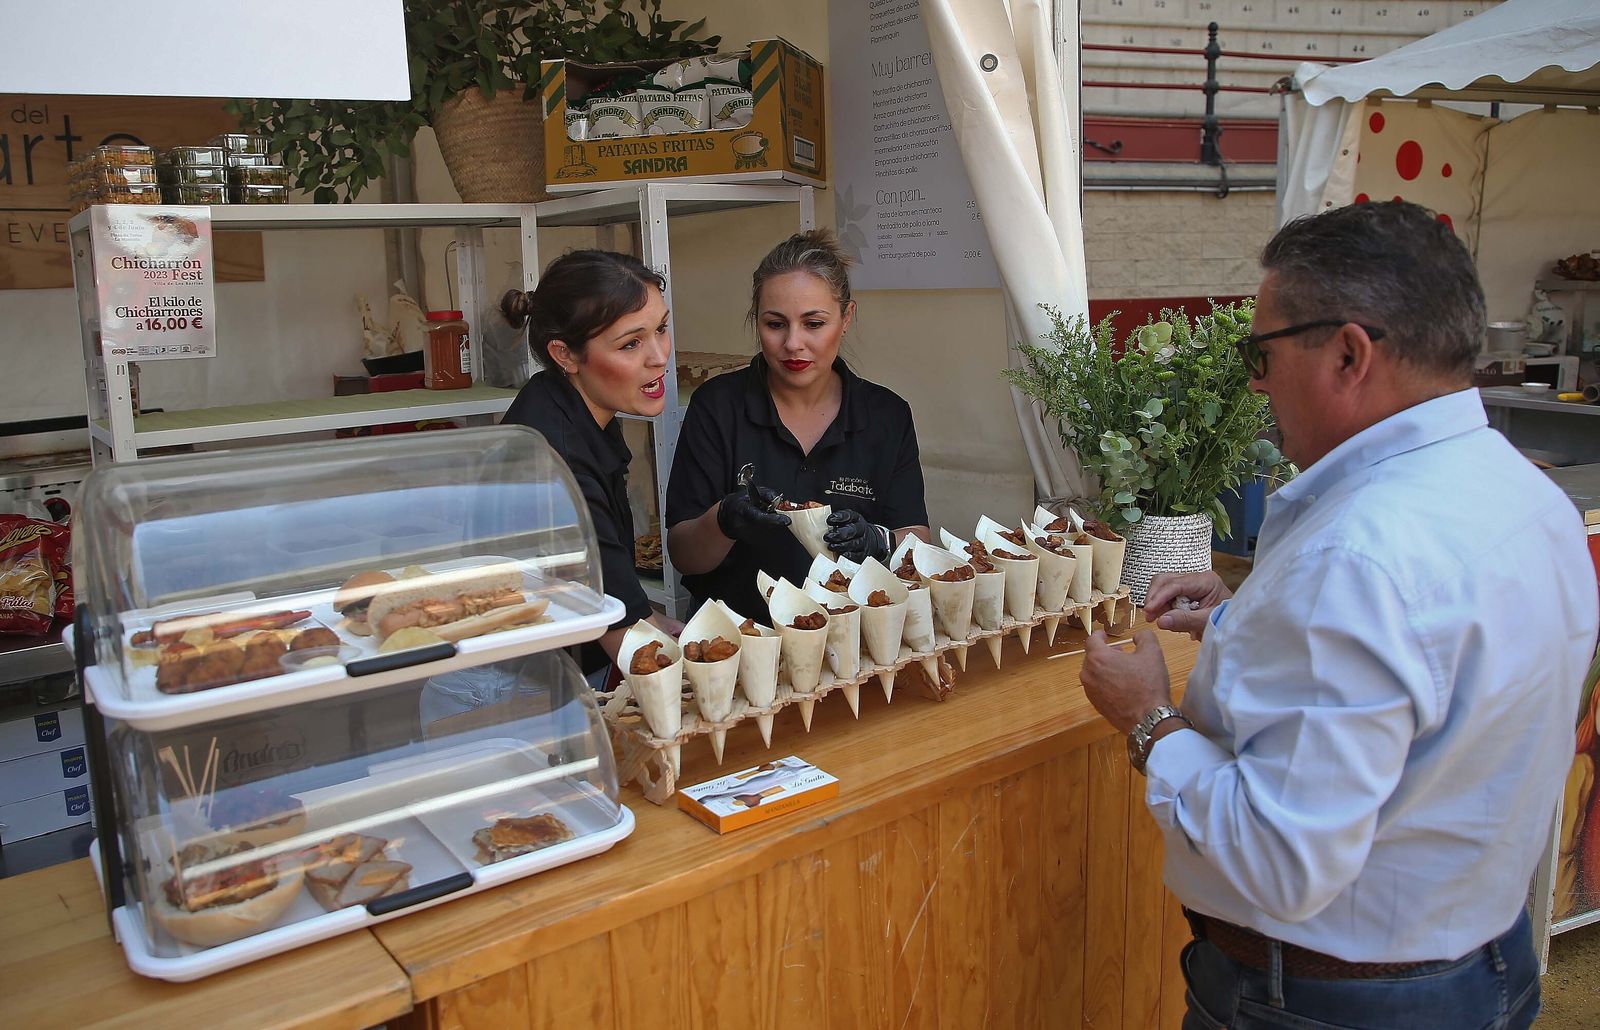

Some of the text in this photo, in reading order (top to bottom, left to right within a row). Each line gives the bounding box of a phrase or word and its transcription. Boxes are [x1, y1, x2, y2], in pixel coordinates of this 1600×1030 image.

[871, 61, 894, 78] Muy
[712, 86, 746, 97] PATATAS
[639, 93, 704, 103] PATATAS FRITAS
[11, 104, 49, 124] del
[594, 107, 625, 118] SANDRA
[653, 107, 685, 118] SANDRA
[598, 137, 715, 158] PATATAS FRITAS
[623, 156, 688, 175] SANDRA
[876, 189, 897, 206] Con
[111, 256, 202, 270] Chicharrón
[144, 268, 204, 280] 2023 Fest
[149, 296, 202, 307] El kilo de
[115, 306, 203, 318] Chicharrones
[136, 317, 203, 332] a 16,00 €
[1, 595, 35, 609] Fritas
[41, 728, 57, 737] Chef
[67, 763, 82, 773] Chef
[70, 802, 85, 811] Chef
